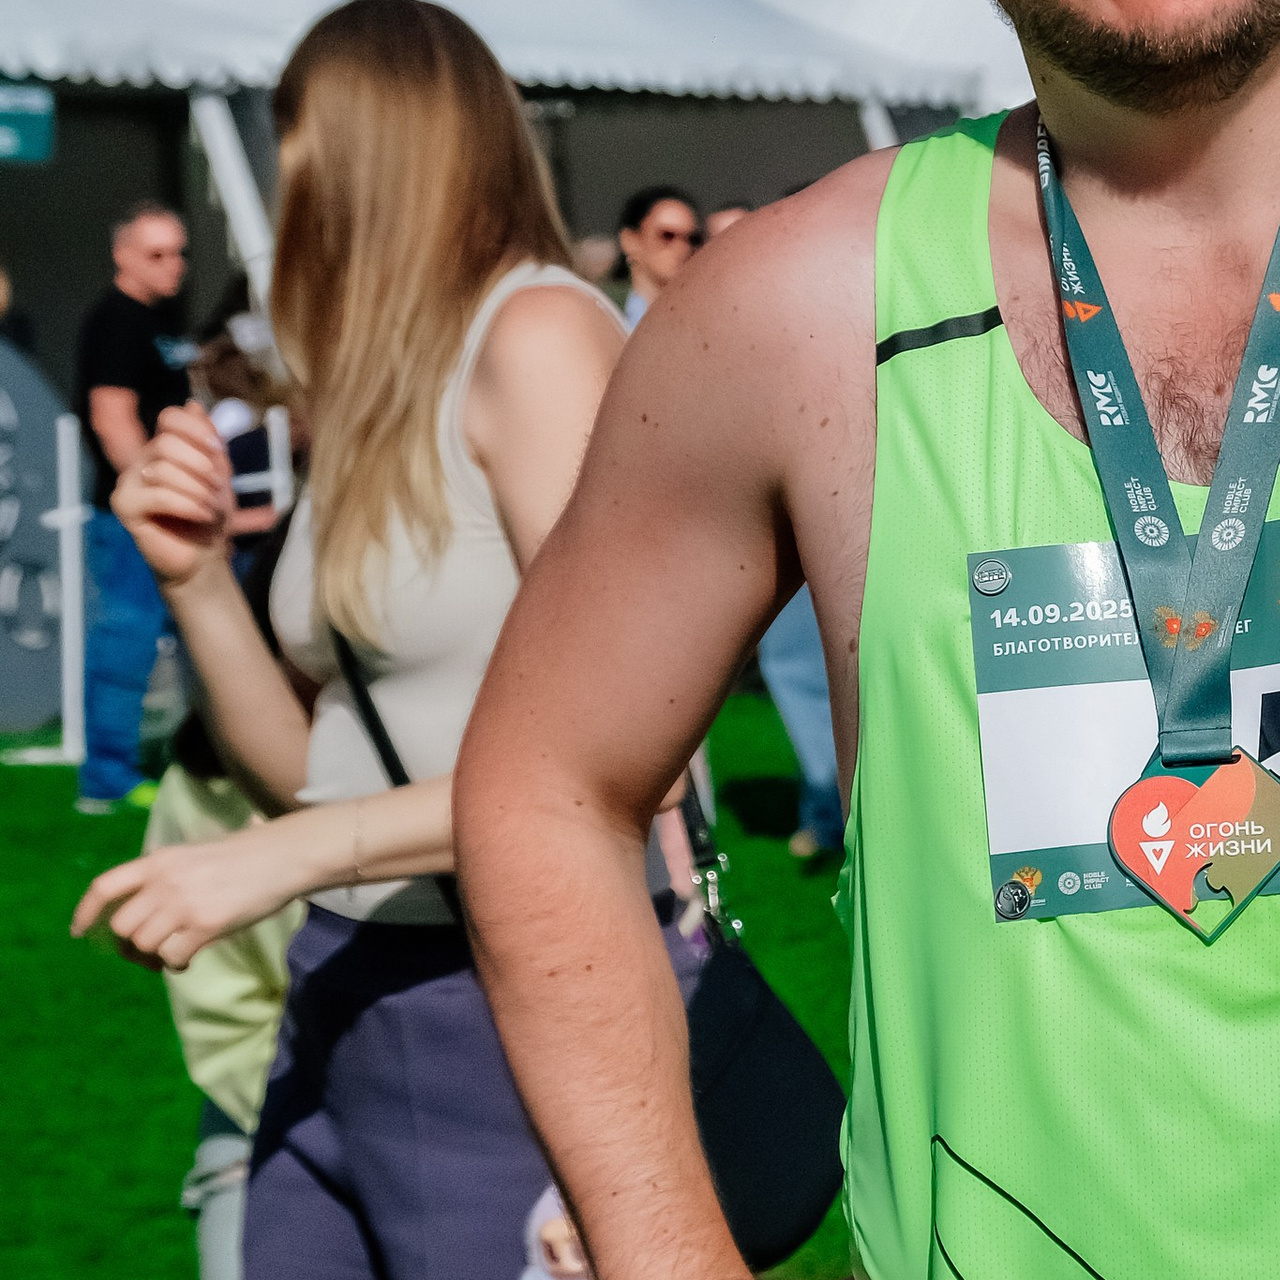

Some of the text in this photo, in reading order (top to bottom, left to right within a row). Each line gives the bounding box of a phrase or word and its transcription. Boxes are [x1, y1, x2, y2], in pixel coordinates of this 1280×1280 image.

[1124, 481, 1140, 513] NOBLE
[1130, 476, 1149, 512] IMPACT
[1143, 486, 1157, 511] CLUB
[1222, 482, 1238, 514] NOBLE
[1230, 476, 1248, 514] IMPACT
[1238, 487, 1253, 514] CLUB
[990, 598, 1133, 629] 14.09.2025
[1189, 821, 1265, 839] ОГОНЬ
[1185, 838, 1272, 859] ЖИЗНИ
